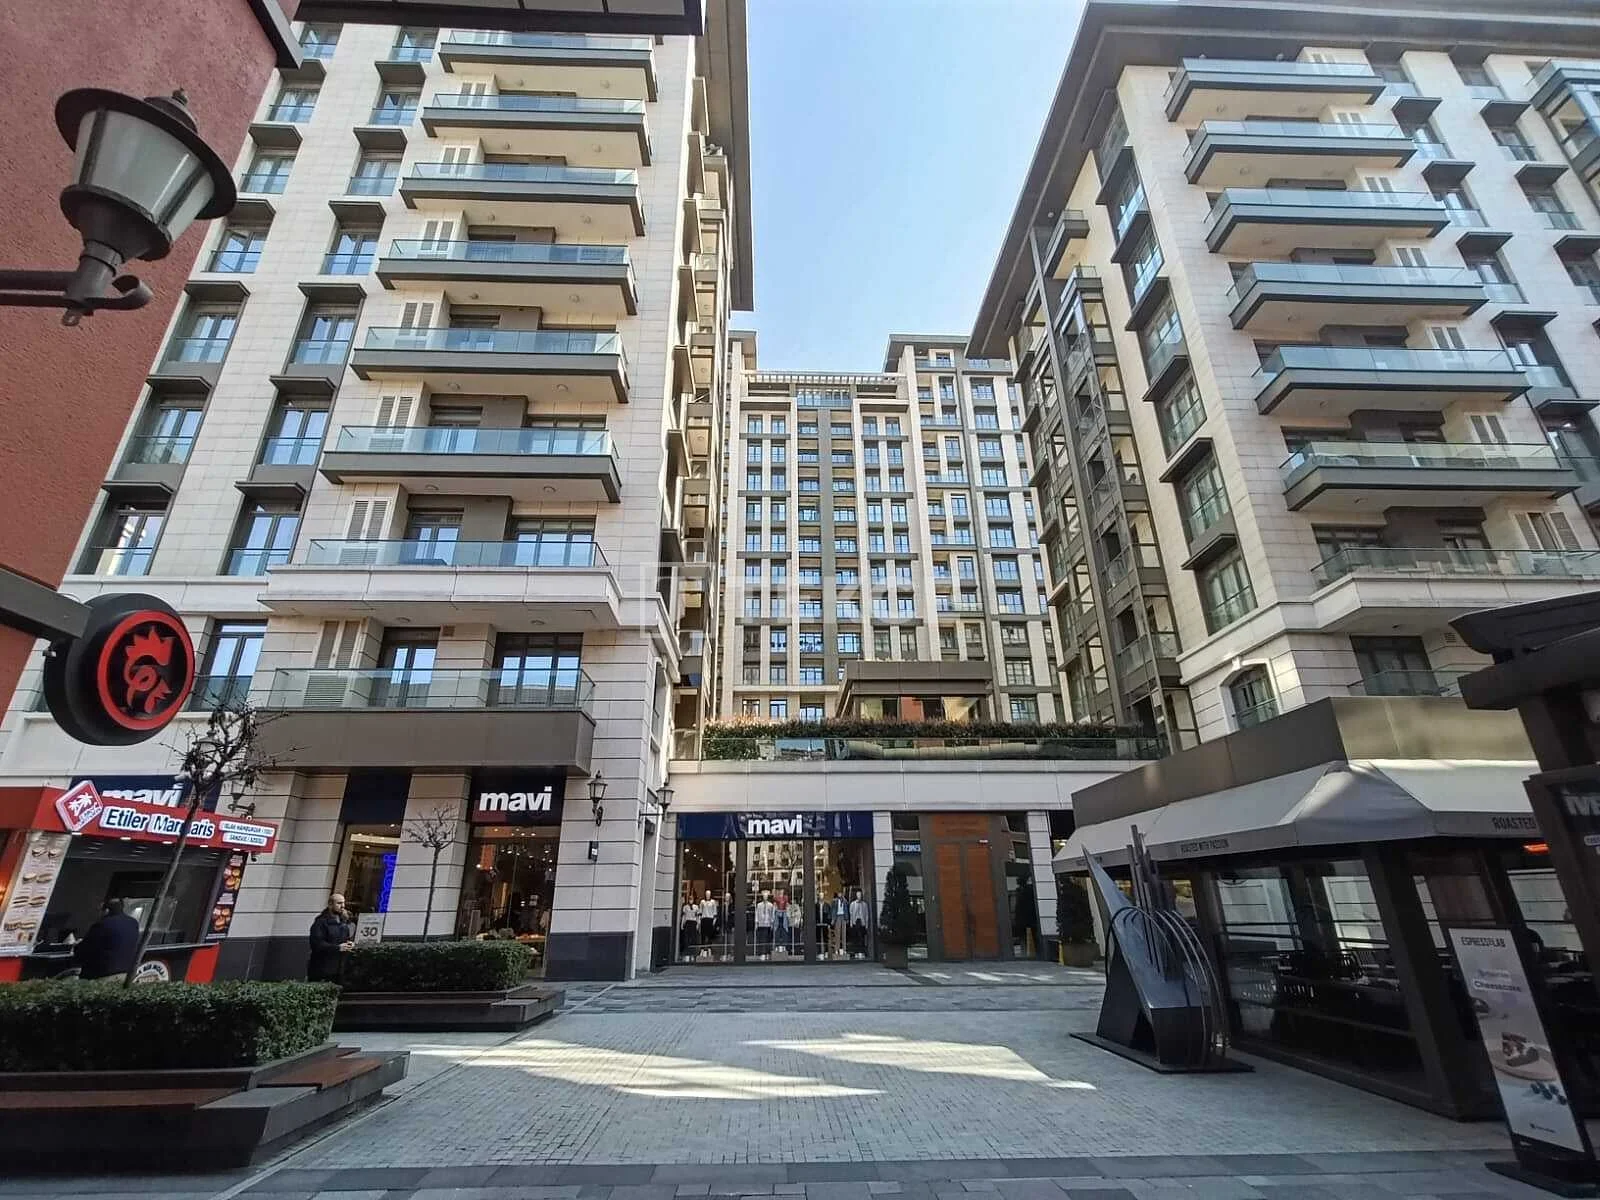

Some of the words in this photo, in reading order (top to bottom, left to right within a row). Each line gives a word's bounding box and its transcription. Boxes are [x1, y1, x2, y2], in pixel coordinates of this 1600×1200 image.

[478, 785, 553, 812] mavi
[105, 808, 149, 830] Etiler
[153, 815, 215, 837] Mararis
[747, 814, 803, 835] mavi
